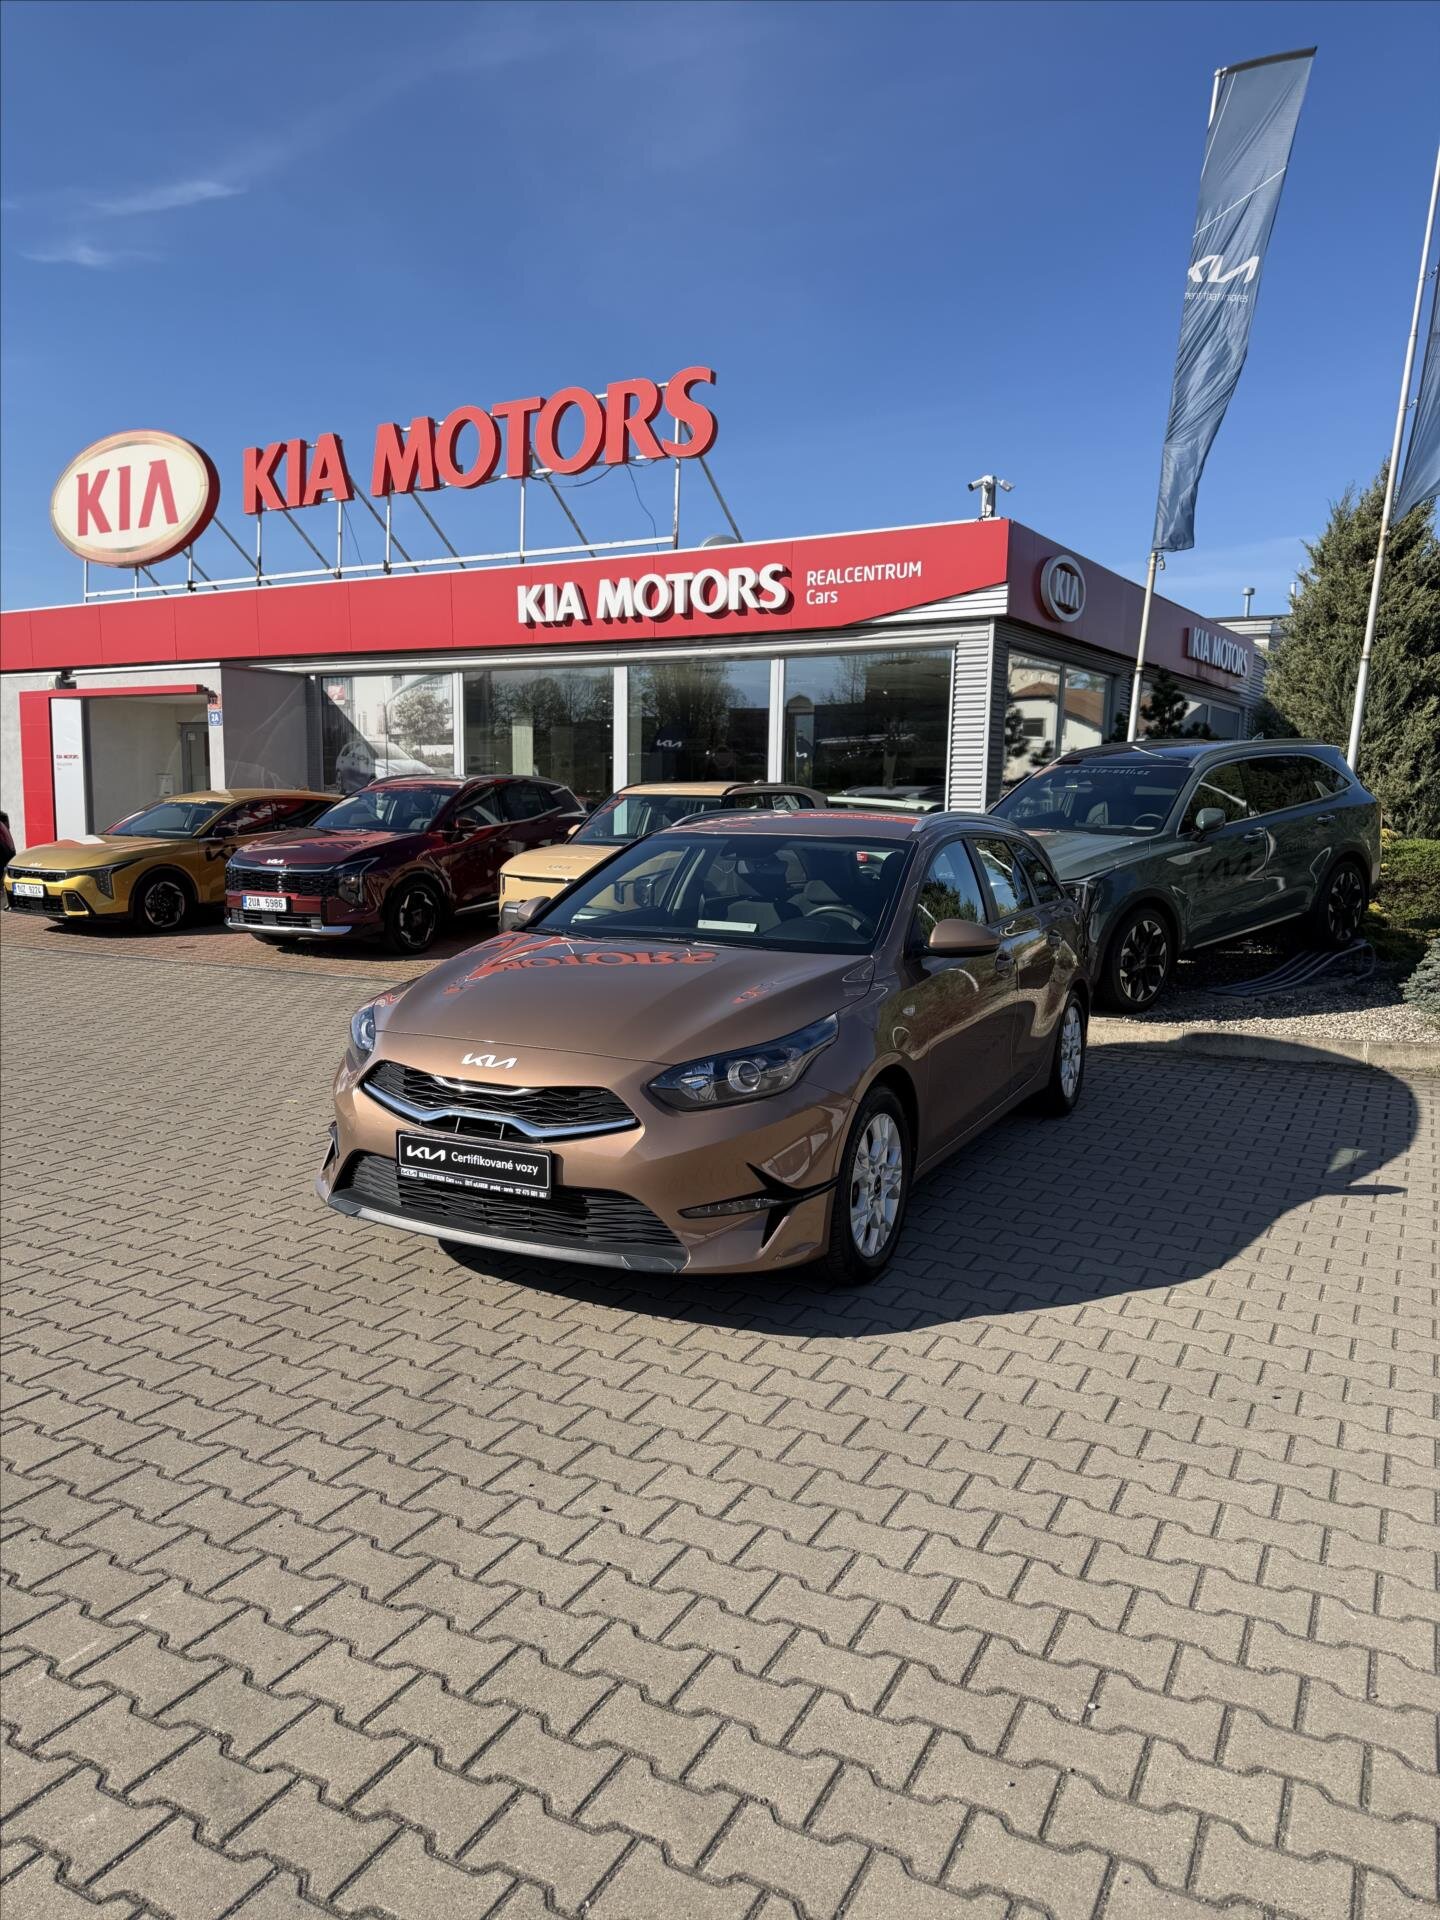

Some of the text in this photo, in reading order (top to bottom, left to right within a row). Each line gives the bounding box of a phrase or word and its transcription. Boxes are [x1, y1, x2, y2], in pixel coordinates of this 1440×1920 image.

[243, 365, 717, 516] KIA MOTORS
[76, 458, 179, 538] KIA
[806, 561, 922, 587] REALCENTRUM
[1055, 567, 1080, 609] KIA
[516, 562, 789, 626] KIA MOTORS
[806, 587, 838, 605] Cars
[1192, 626, 1249, 678] KIA MOTORS
[248, 897, 284, 909] 2UA 5986
[461, 1052, 518, 1070] KIA
[405, 1144, 539, 1176] KIA Certifikované vozy
